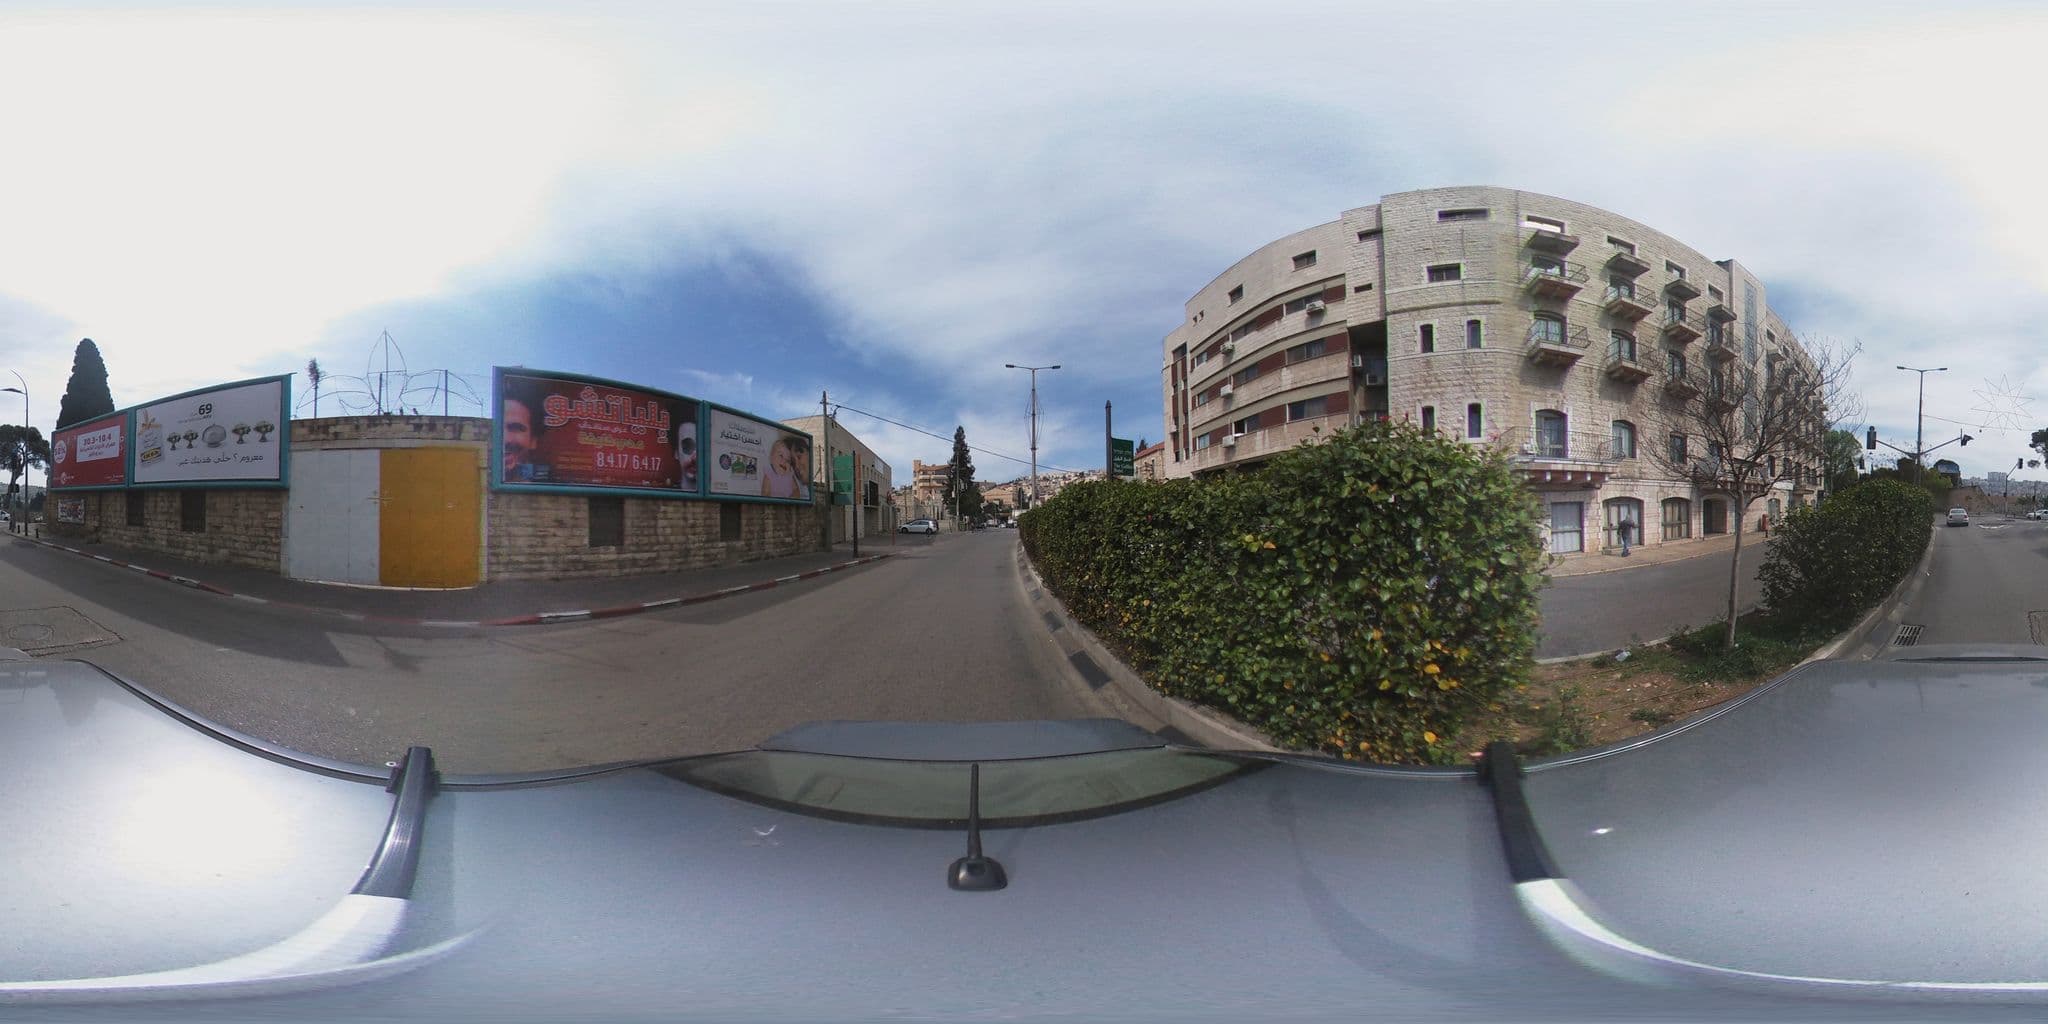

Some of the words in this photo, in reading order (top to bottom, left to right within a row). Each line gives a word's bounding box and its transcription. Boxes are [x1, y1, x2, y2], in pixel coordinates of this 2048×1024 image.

[198, 403, 213, 416] 69
[596, 451, 629, 470] 8.4.17
[632, 454, 662, 472] 6.4.17
